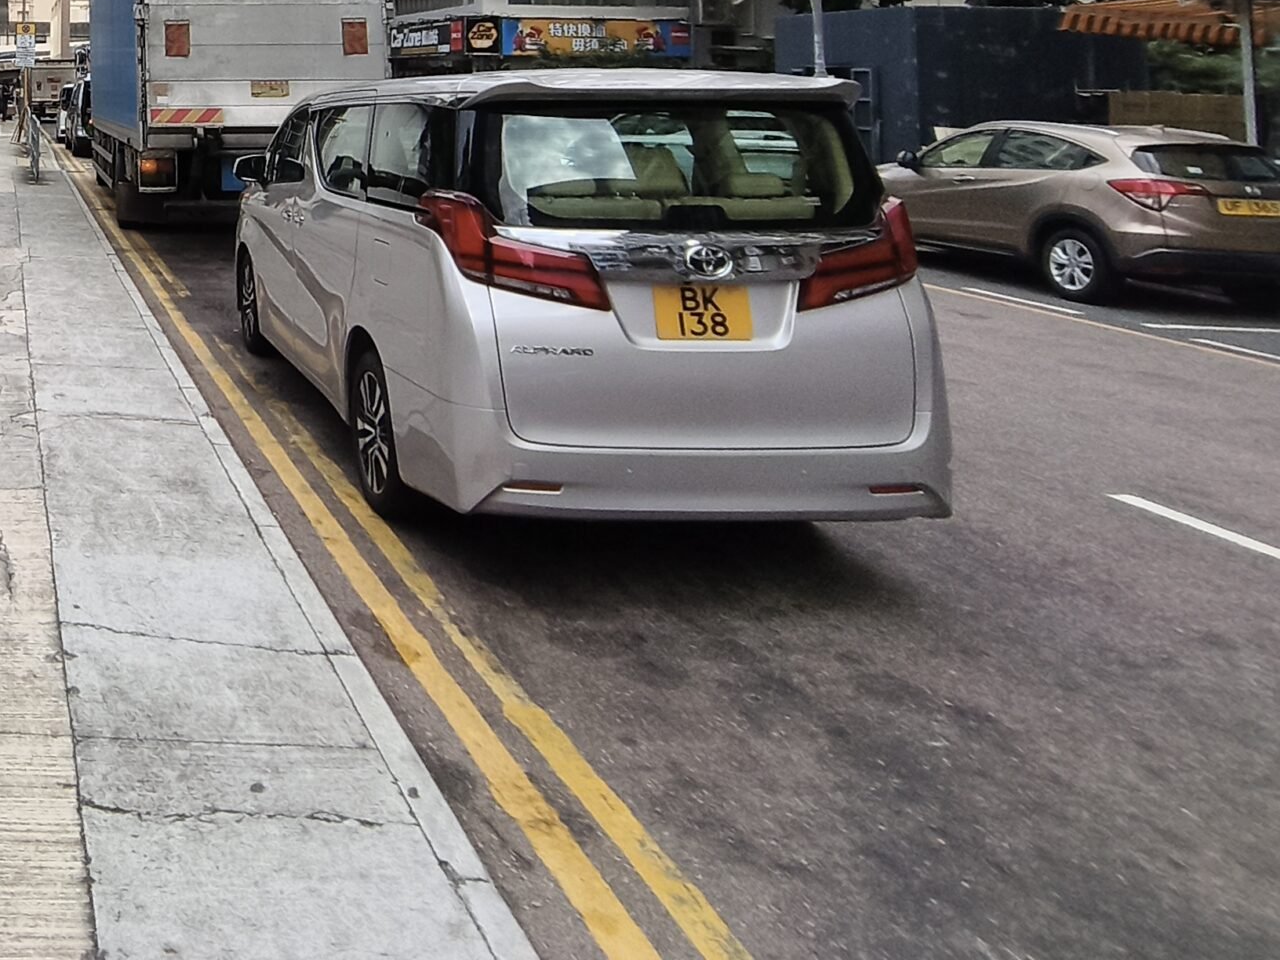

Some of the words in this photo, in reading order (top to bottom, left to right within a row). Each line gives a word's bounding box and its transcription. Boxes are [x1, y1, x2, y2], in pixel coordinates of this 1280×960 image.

[471, 31, 494, 40] Zone
[680, 286, 722, 311] BK
[678, 311, 729, 336] 138
